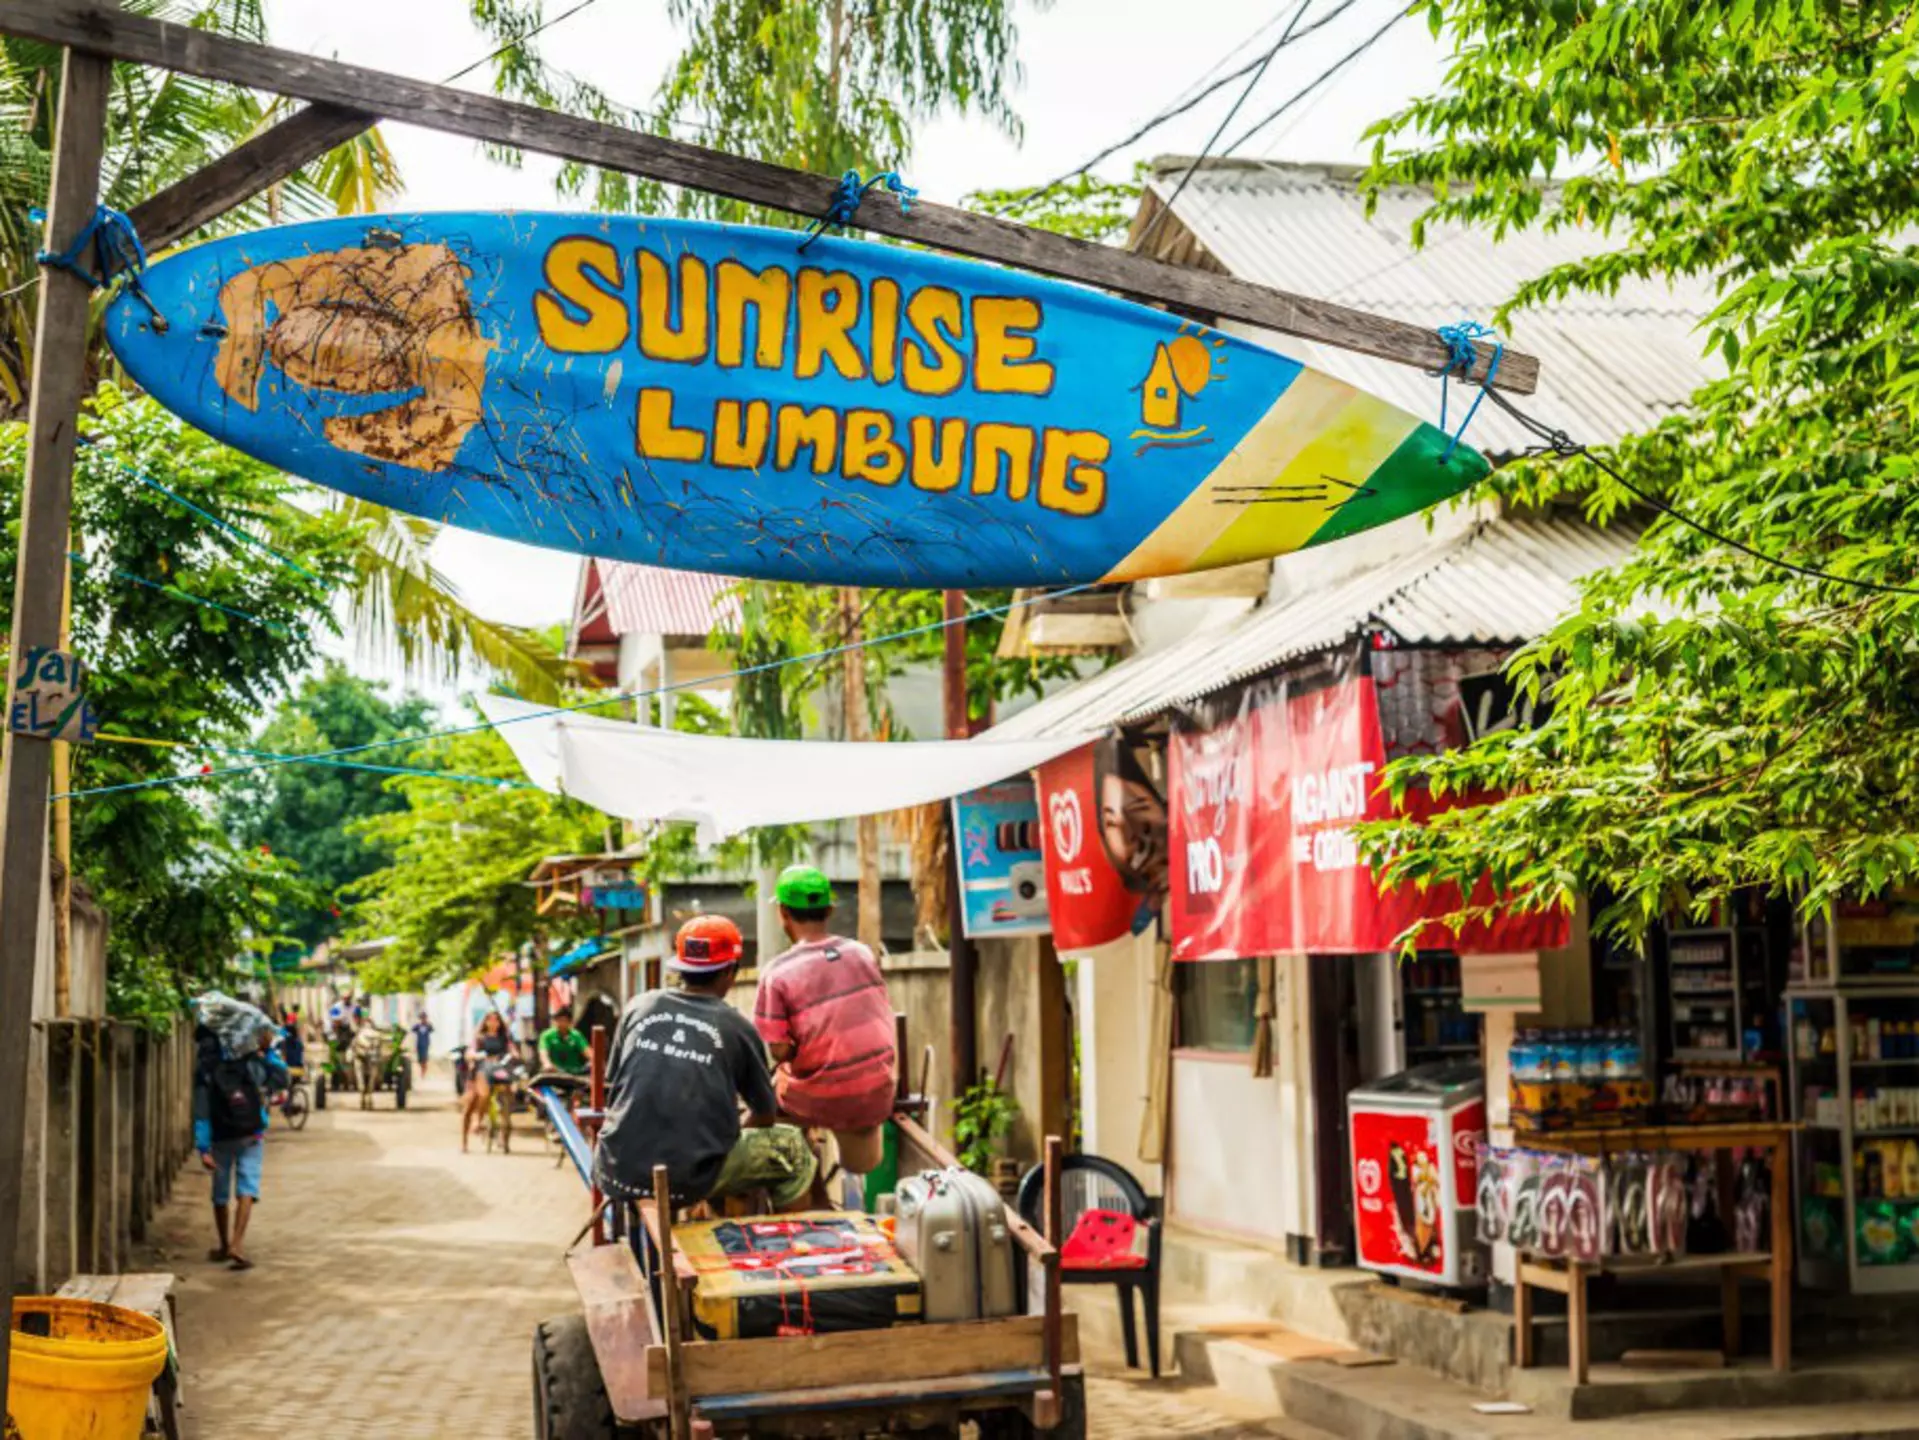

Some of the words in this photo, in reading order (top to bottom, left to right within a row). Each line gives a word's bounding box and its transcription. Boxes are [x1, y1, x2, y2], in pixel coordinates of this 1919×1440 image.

[532, 234, 1055, 397] SUNRISE
[635, 385, 1111, 517] LUMBUNG
[1291, 761, 1375, 824] AGAINST
[1187, 836, 1223, 895] PRO
